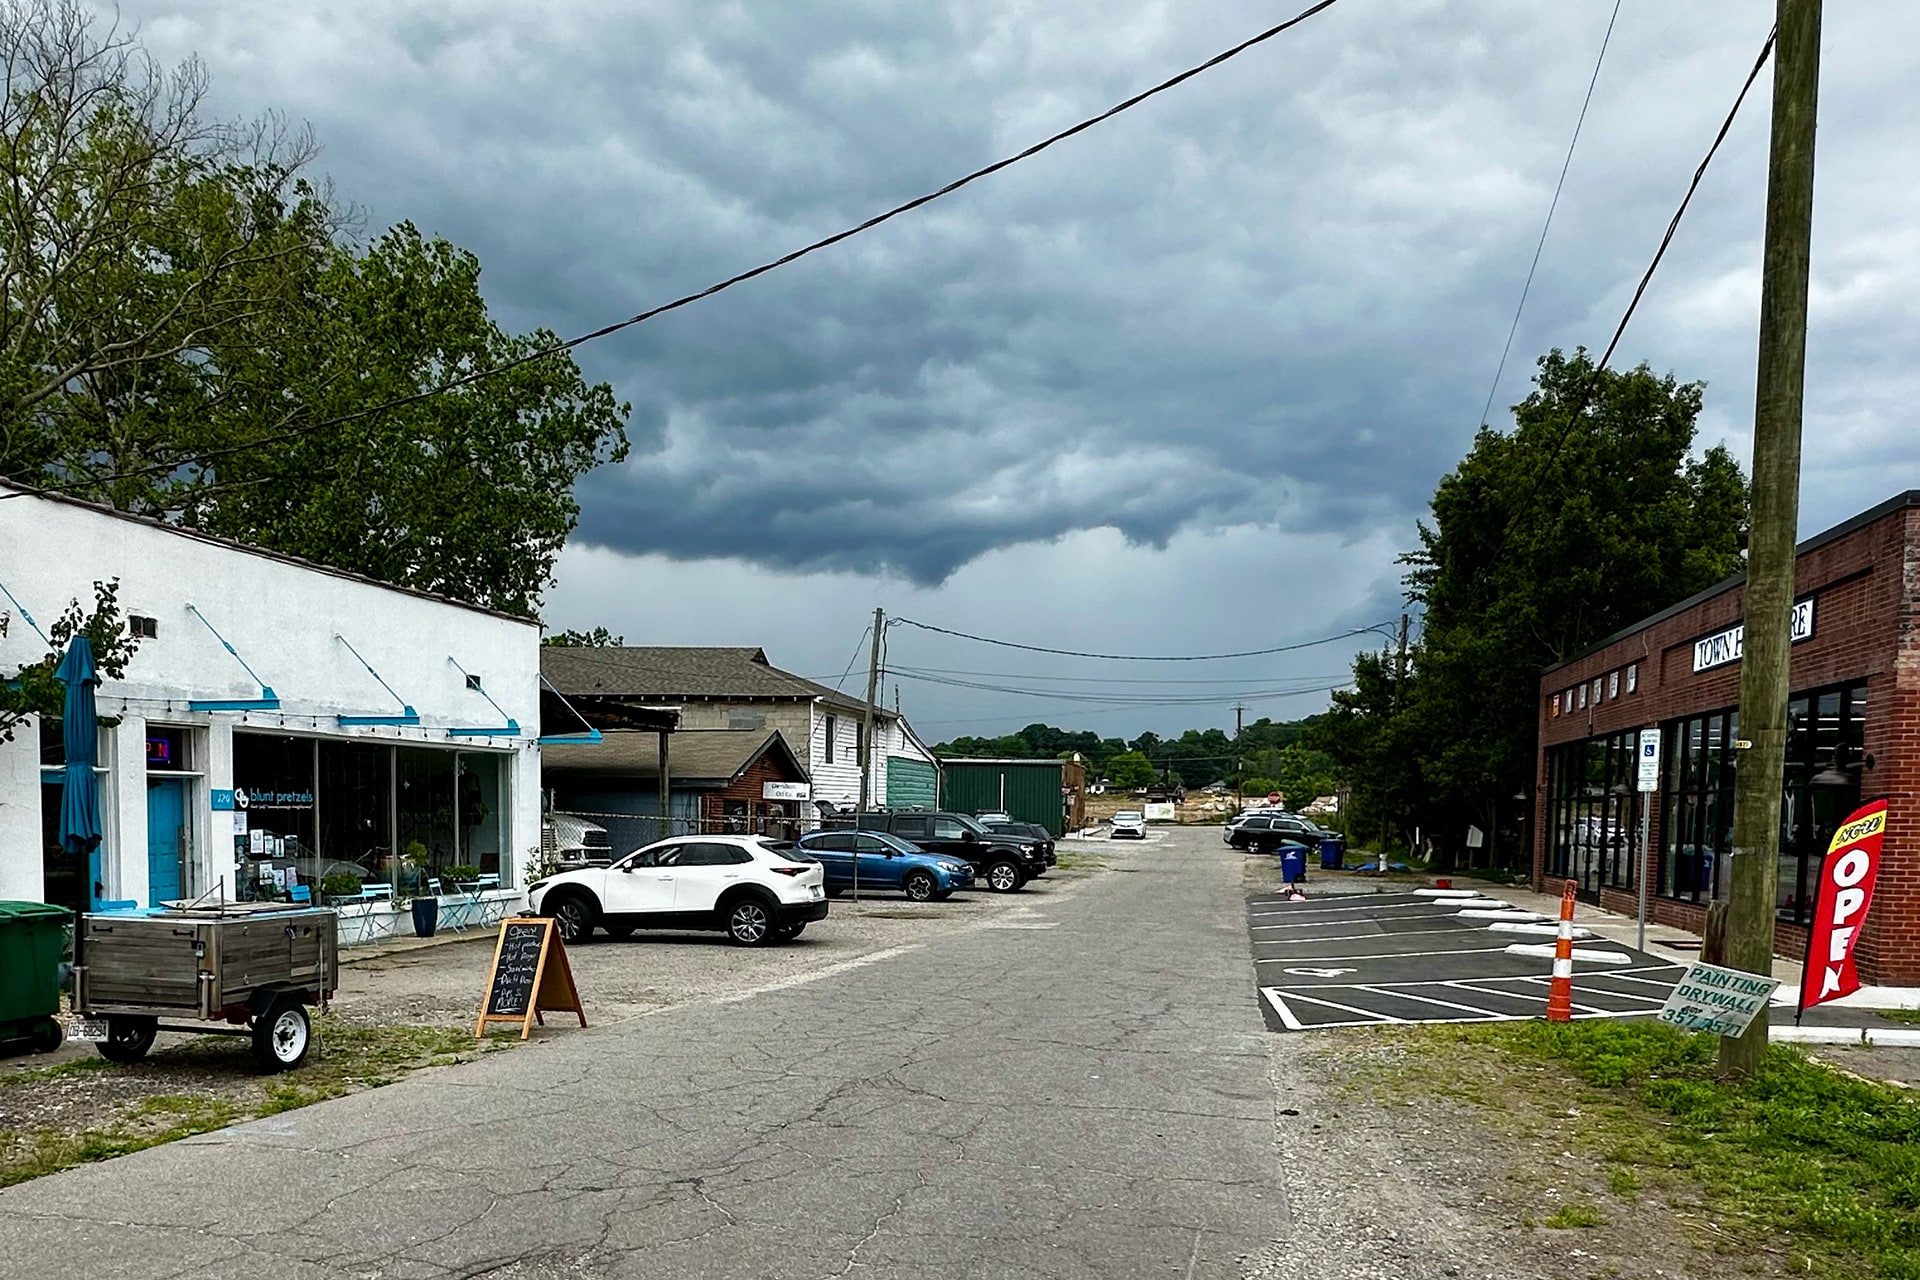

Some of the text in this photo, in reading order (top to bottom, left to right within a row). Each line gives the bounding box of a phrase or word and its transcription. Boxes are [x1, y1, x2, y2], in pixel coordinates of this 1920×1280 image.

[1699, 632, 1732, 667] TOWN
[250, 787, 313, 805] blunt pretzels
[1836, 816, 1883, 845] NOW
[1819, 849, 1870, 999] OPEN
[1689, 968, 1772, 995] PAINTING
[1678, 985, 1755, 1012] DRYWALL
